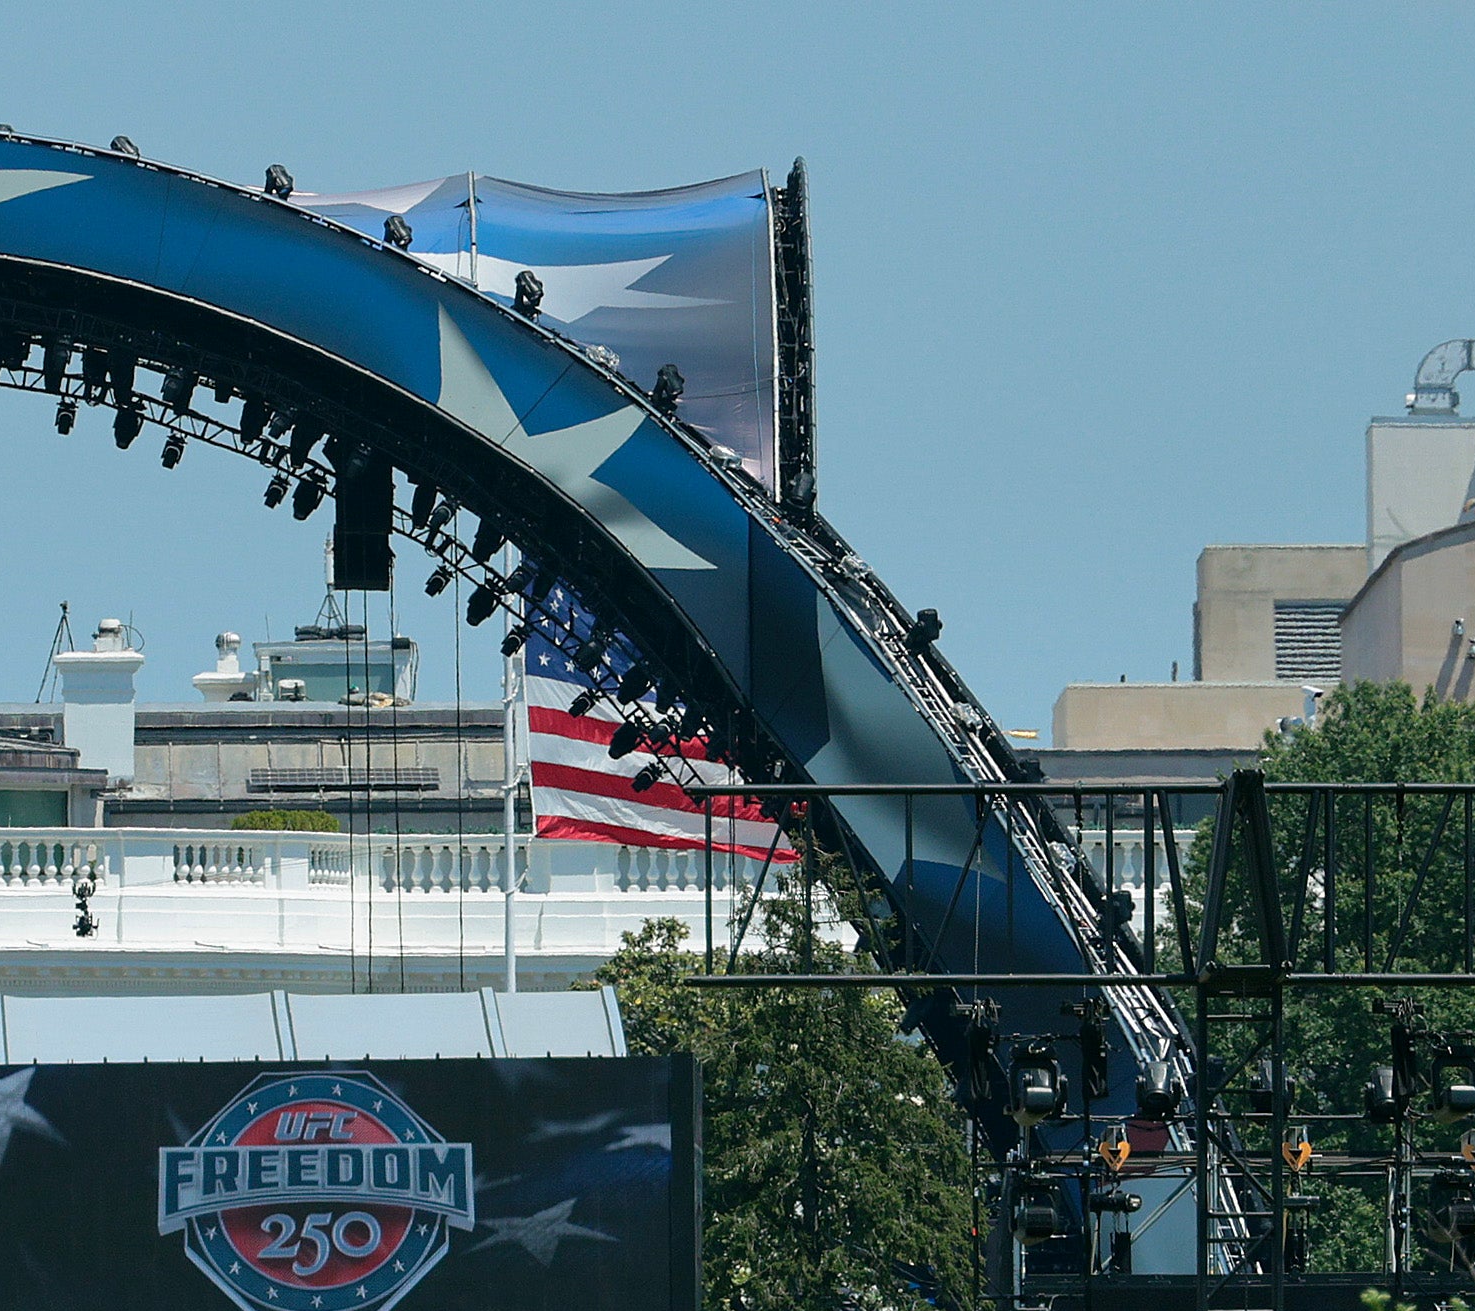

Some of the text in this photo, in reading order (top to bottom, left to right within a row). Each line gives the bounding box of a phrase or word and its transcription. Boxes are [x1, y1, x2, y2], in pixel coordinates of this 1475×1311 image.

[274, 1111, 359, 1141] UFC
[164, 1147, 470, 1217] FREEDOM
[256, 1210, 381, 1276] 250
